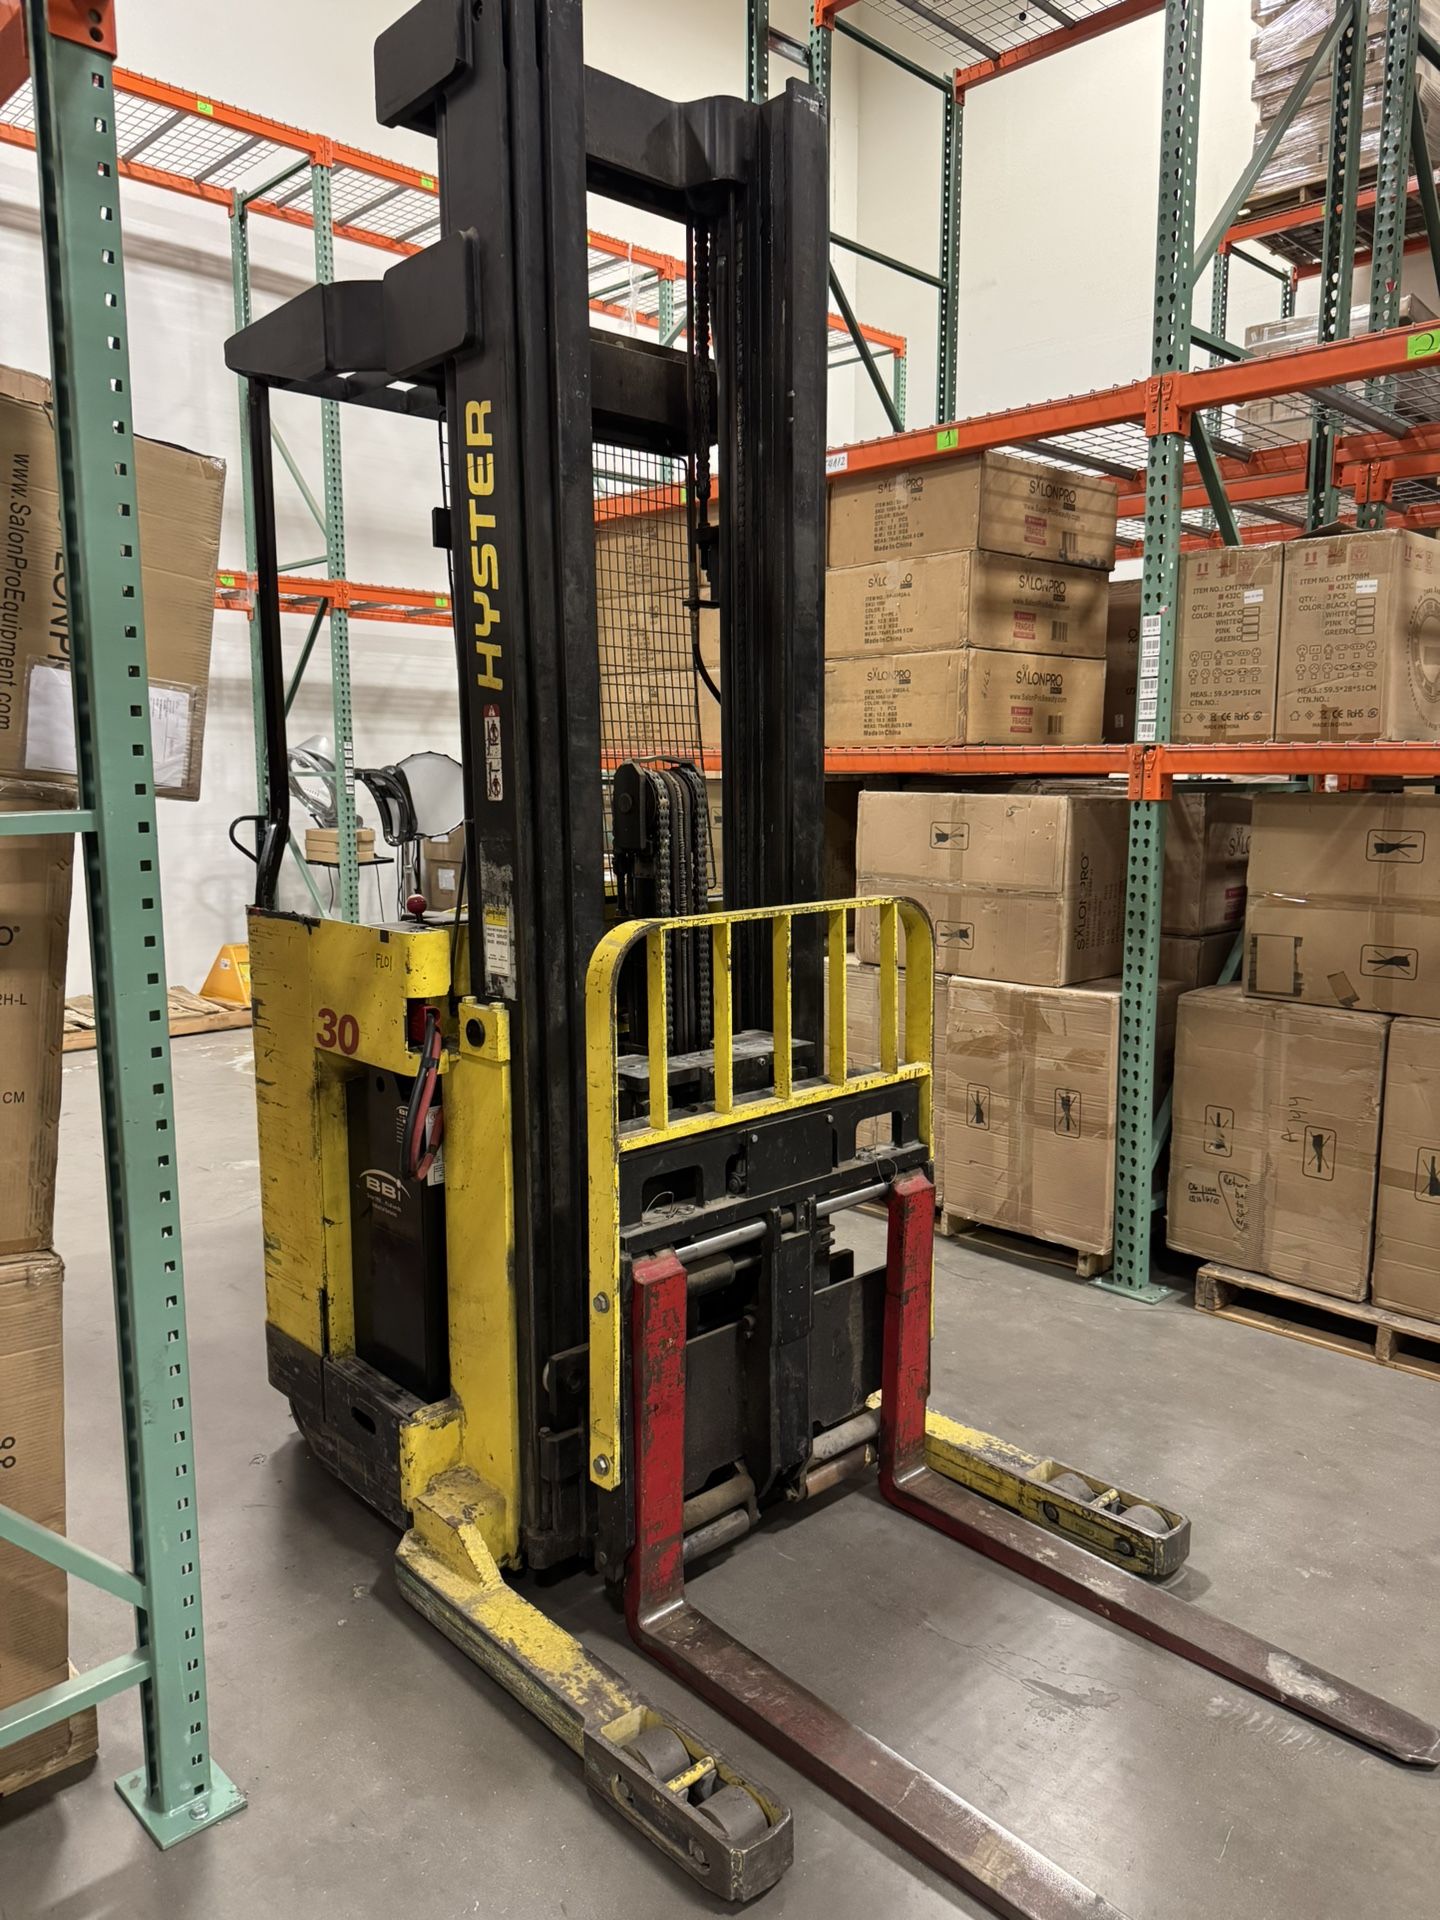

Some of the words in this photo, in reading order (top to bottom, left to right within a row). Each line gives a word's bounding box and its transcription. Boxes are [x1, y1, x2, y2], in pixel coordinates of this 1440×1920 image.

[1415, 333, 1438, 355] 2
[944, 430, 952, 448] 1
[465, 400, 503, 690] HYSTER
[1299, 577, 1318, 586] ITEM
[1193, 586, 1208, 595] ITEM
[1222, 601, 1235, 609] PCS
[1325, 602, 1349, 610] BLACK
[316, 1007, 360, 1056] 30
